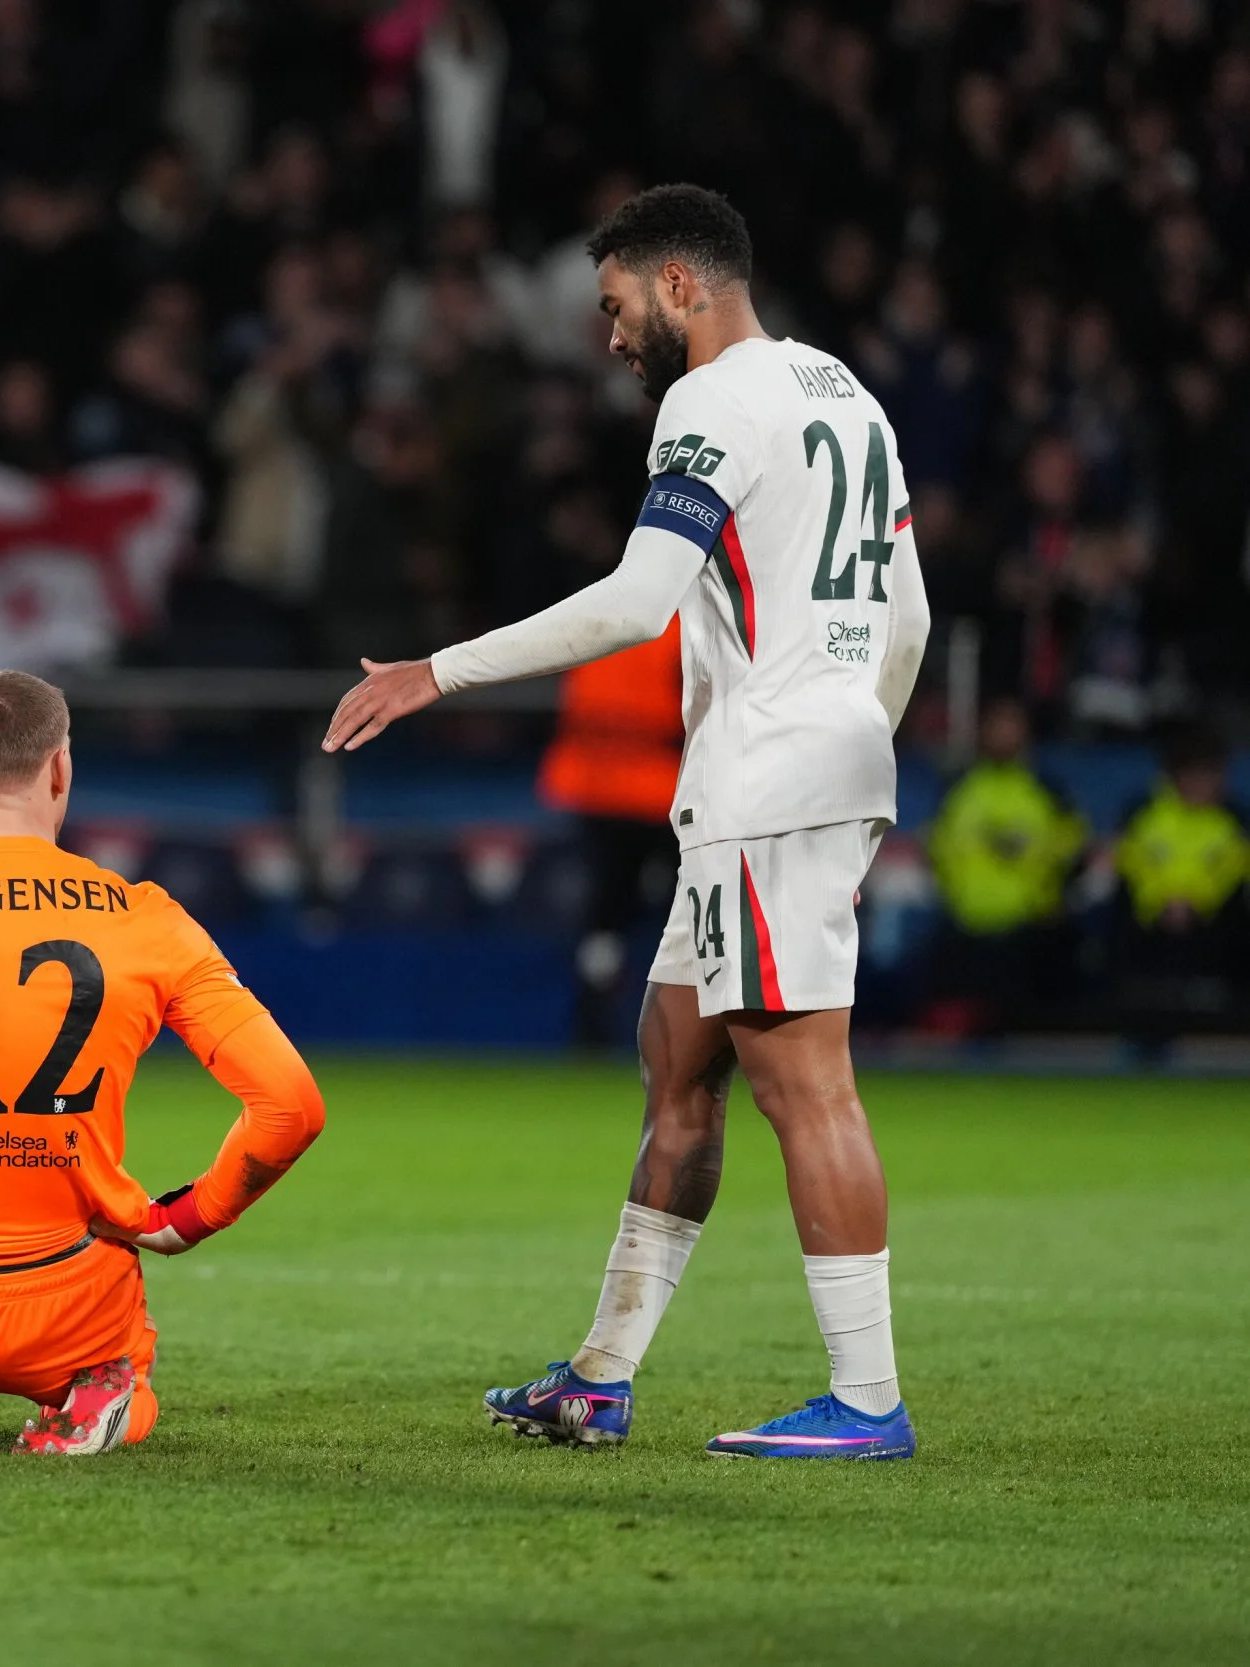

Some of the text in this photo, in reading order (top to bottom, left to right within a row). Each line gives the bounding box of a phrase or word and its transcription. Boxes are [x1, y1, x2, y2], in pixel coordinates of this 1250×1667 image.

[788, 363, 855, 400] JAMES
[657, 444, 719, 470] FPT
[668, 496, 718, 527] RESPECT
[803, 419, 895, 603] 24
[687, 884, 725, 960] 24
